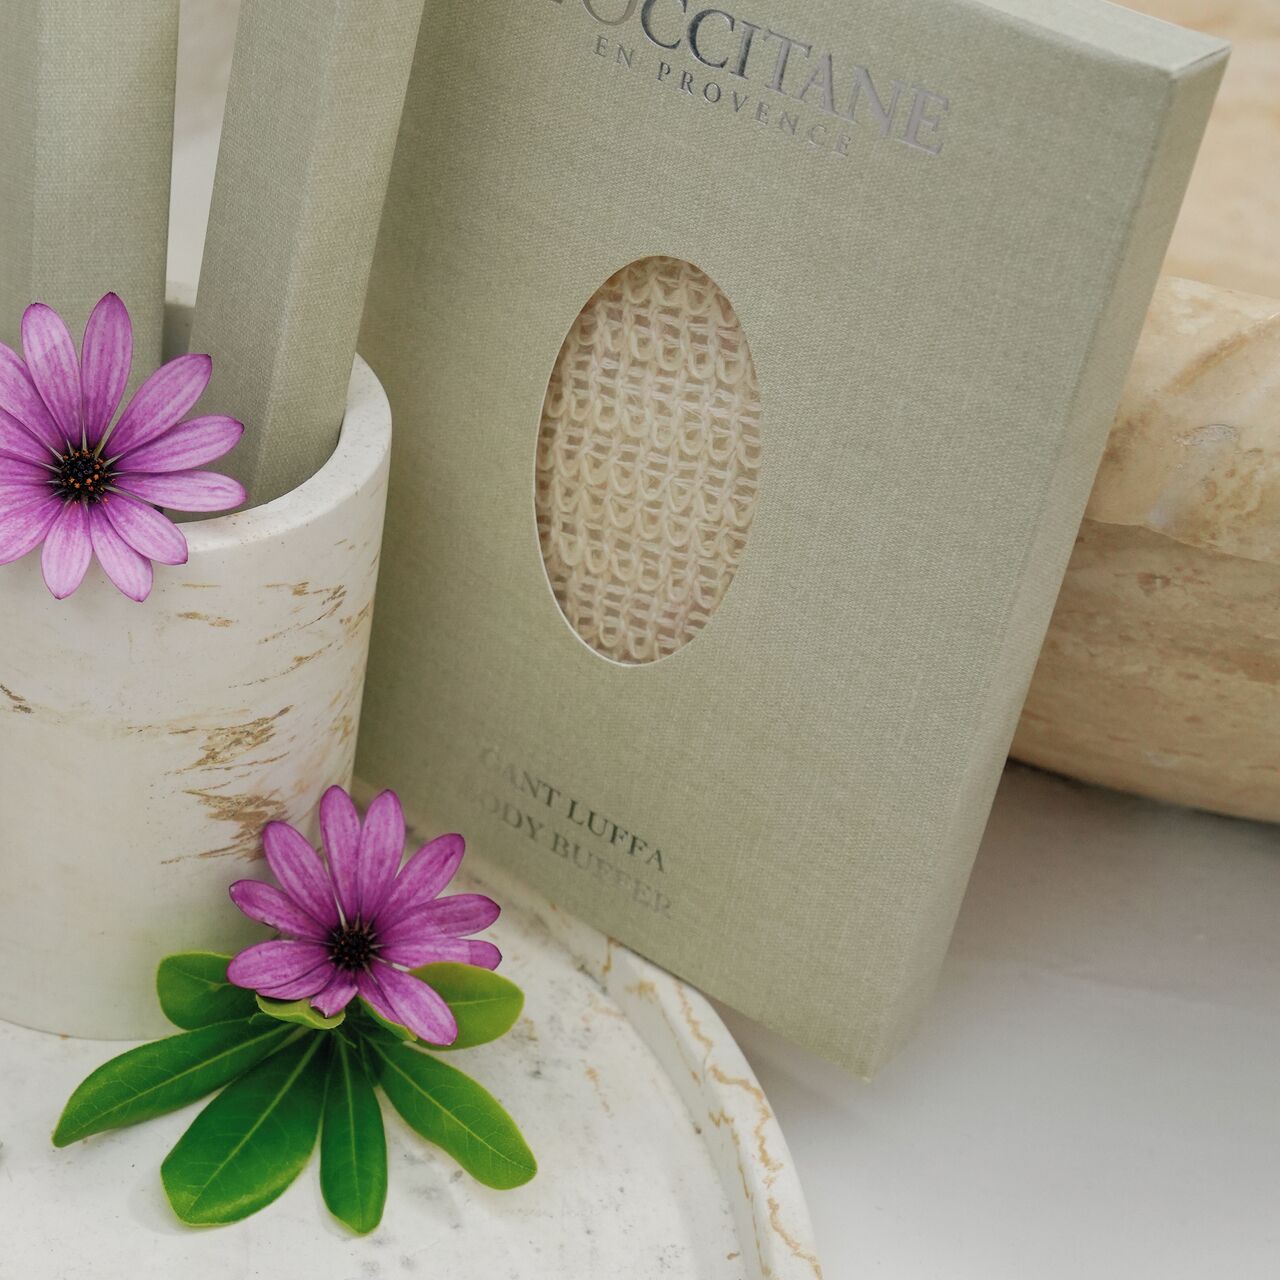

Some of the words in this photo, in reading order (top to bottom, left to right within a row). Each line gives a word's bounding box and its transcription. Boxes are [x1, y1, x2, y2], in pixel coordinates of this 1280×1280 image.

[593, 34, 634, 68] EN
[656, 61, 851, 157] PROVENCE
[567, 799, 665, 873] LUFFA
